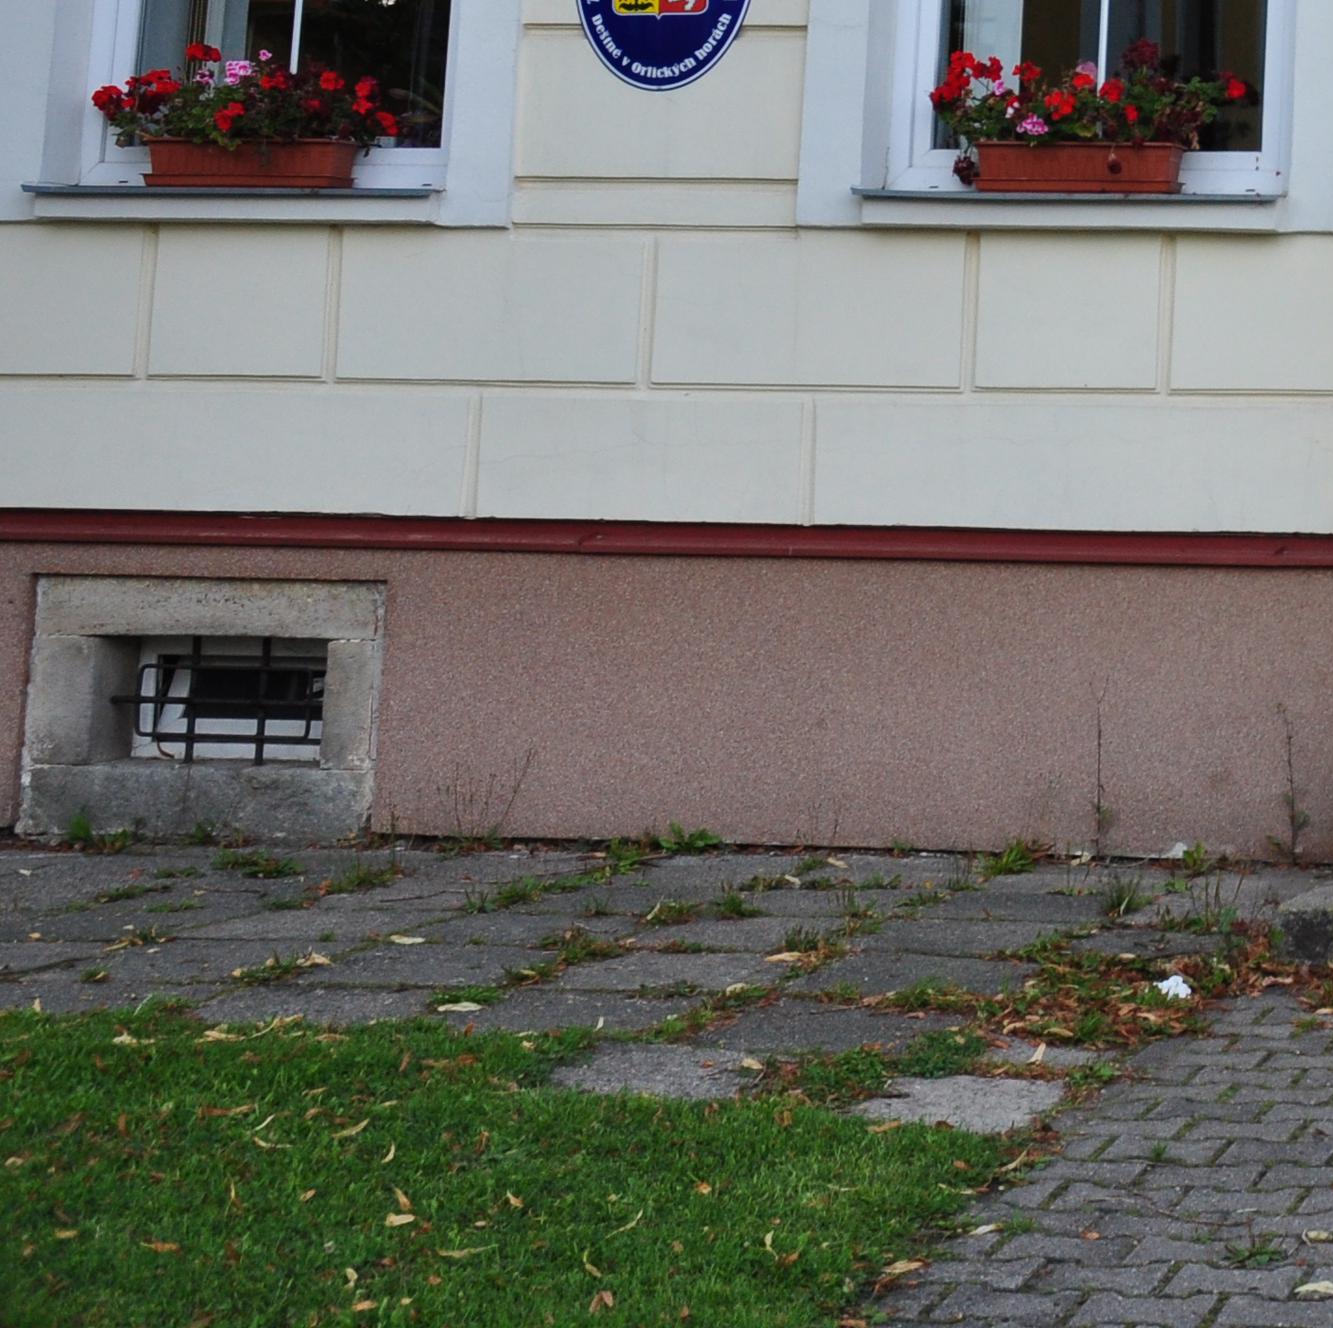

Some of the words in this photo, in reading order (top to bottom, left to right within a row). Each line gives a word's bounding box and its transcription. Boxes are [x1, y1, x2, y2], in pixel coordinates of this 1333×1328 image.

[591, 13, 622, 59] Deštné
[621, 56, 631, 67] v
[631, 55, 697, 78] Orlických
[697, 14, 732, 60] horách
